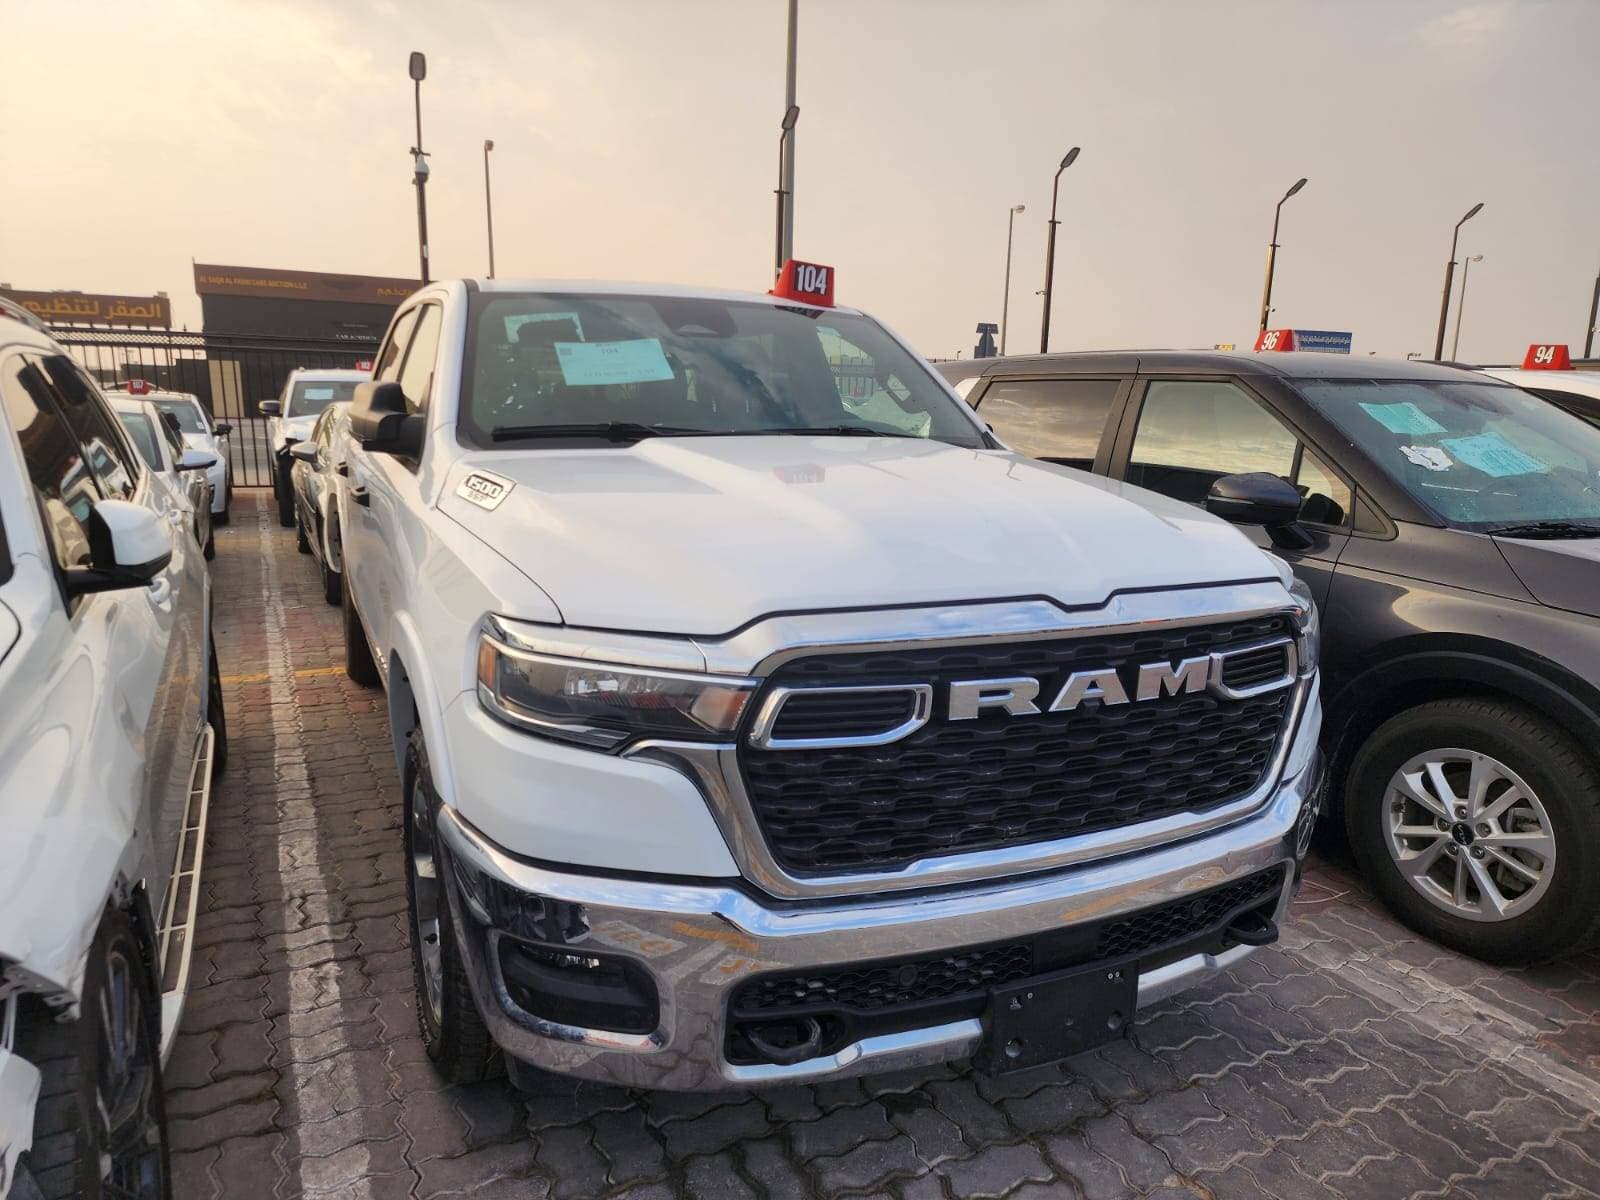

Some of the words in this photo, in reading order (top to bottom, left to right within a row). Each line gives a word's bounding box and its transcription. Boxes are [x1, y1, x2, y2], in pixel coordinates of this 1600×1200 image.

[797, 265, 827, 295] 104
[104, 300, 161, 319] الصقر
[1261, 331, 1279, 350] 96
[1534, 346, 1555, 364] 94
[468, 476, 502, 498] 1500
[948, 655, 1210, 721] RAM
